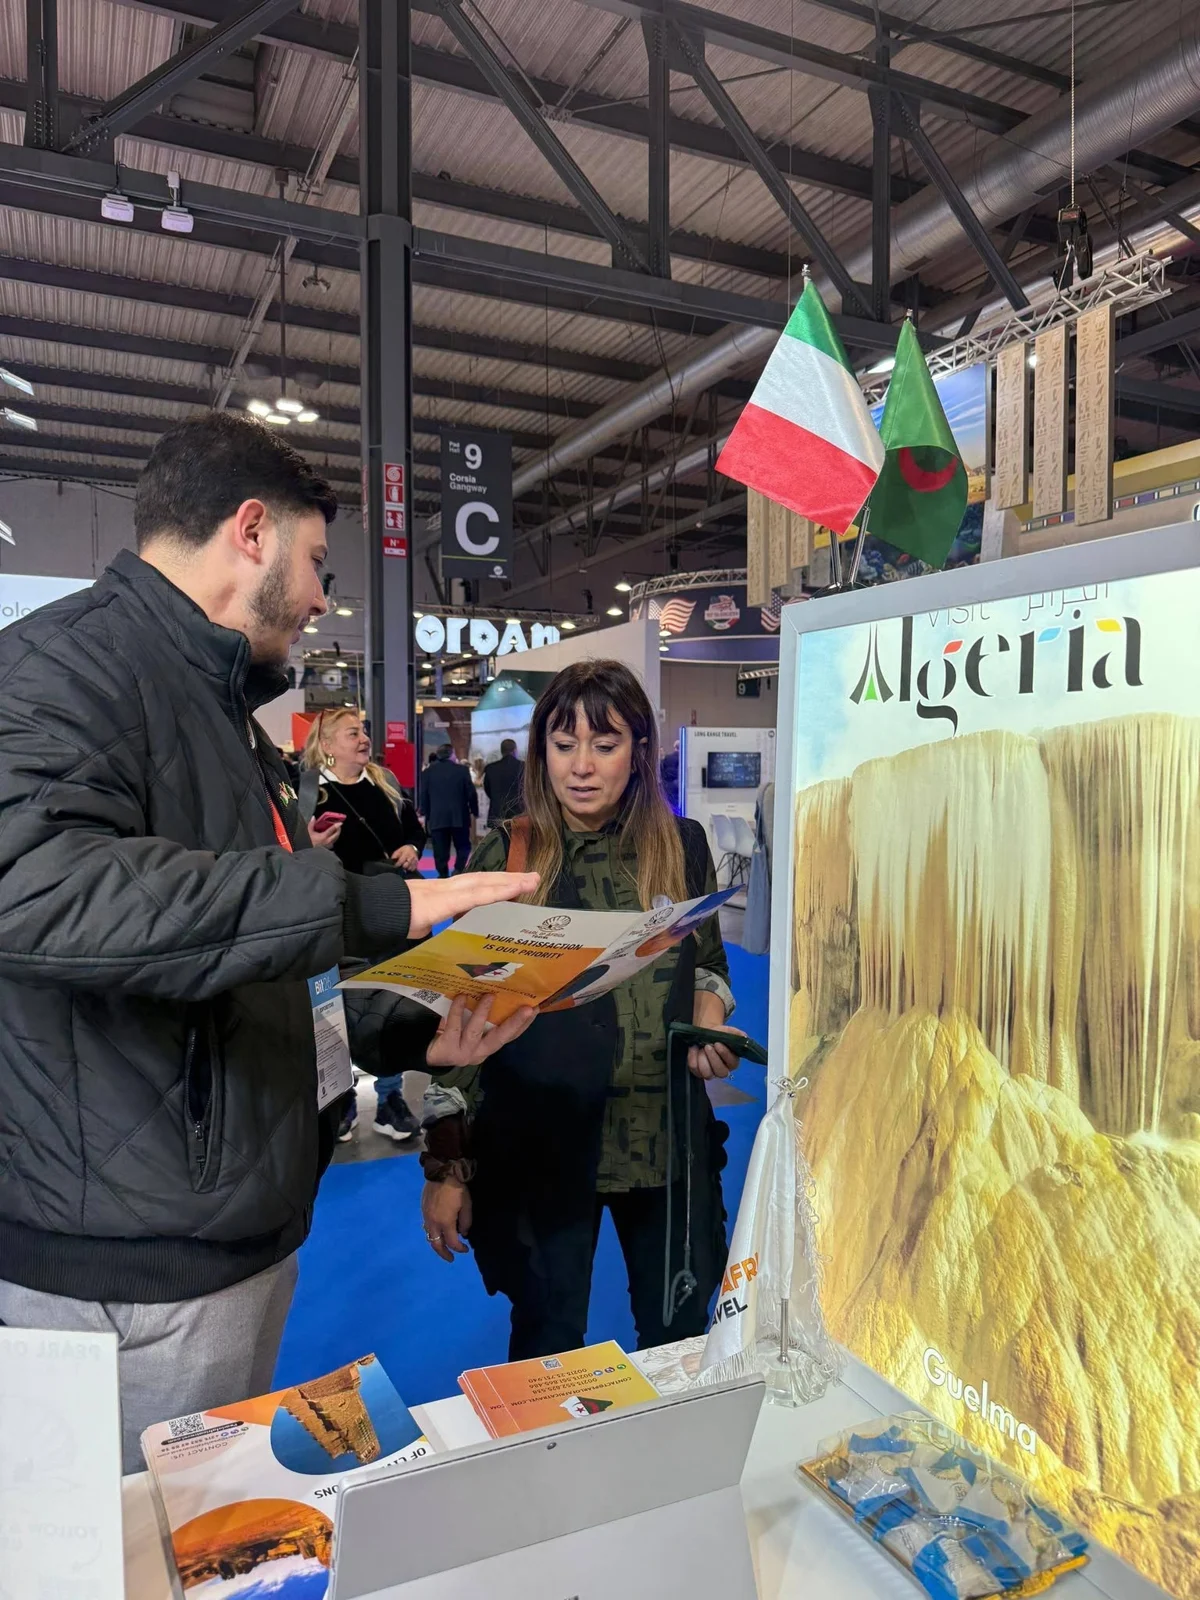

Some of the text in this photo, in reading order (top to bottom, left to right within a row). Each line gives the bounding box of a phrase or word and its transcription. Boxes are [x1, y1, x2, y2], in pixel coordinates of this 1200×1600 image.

[464, 443, 483, 470] 9
[449, 472, 477, 484] Corsia
[449, 481, 487, 494] Gangway
[455, 501, 500, 556] C
[848, 606, 1144, 737] Algeria
[484, 933, 584, 951] YOUR SATISFACTION
[495, 945, 519, 954] OUR
[518, 949, 564, 959] PRIORITY
[922, 1346, 1037, 1456] Guelma
[187, 1441, 228, 1456] CONTACT
[409, 1446, 427, 1459] OF
